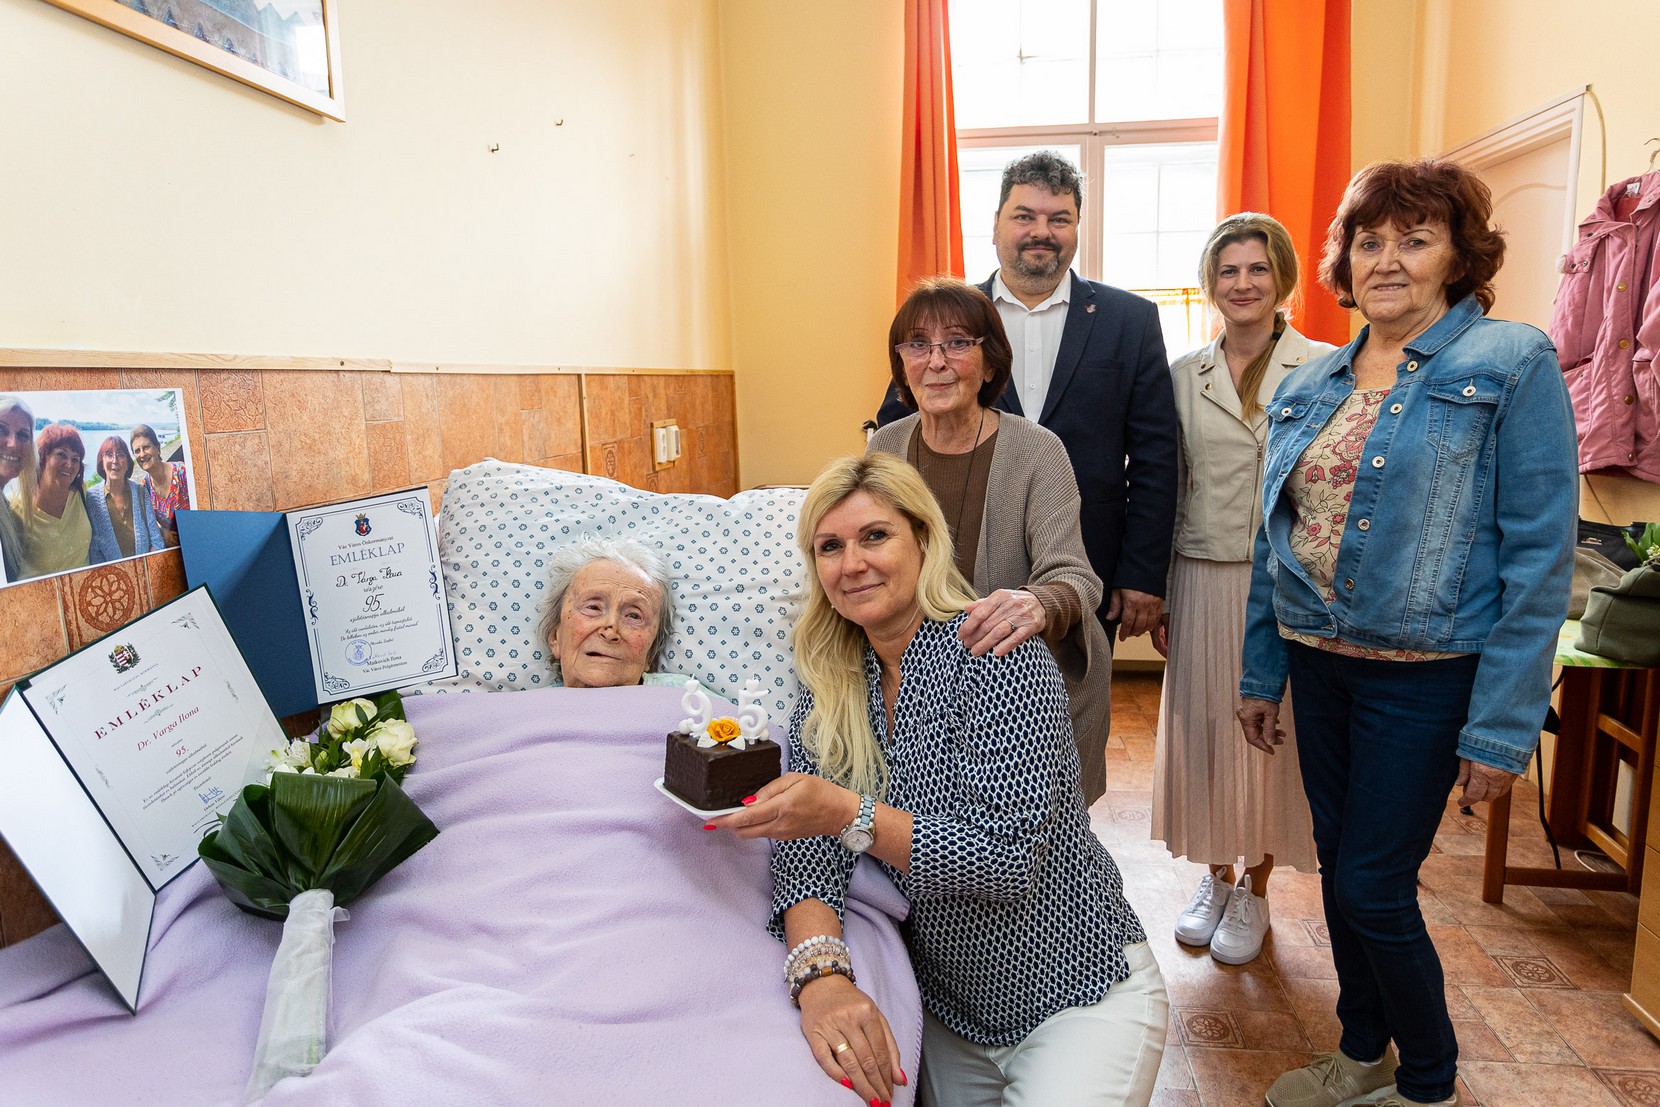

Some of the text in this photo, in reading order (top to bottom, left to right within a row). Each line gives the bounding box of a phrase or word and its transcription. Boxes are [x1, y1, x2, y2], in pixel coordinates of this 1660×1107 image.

[330, 543, 405, 566] EMLÉKLAP
[94, 665, 202, 740] EMLÉKLAP
[137, 737, 152, 751] Dr.
[152, 720, 178, 740] Varga
[178, 705, 200, 724] Ilona
[175, 745, 190, 758] 95.
